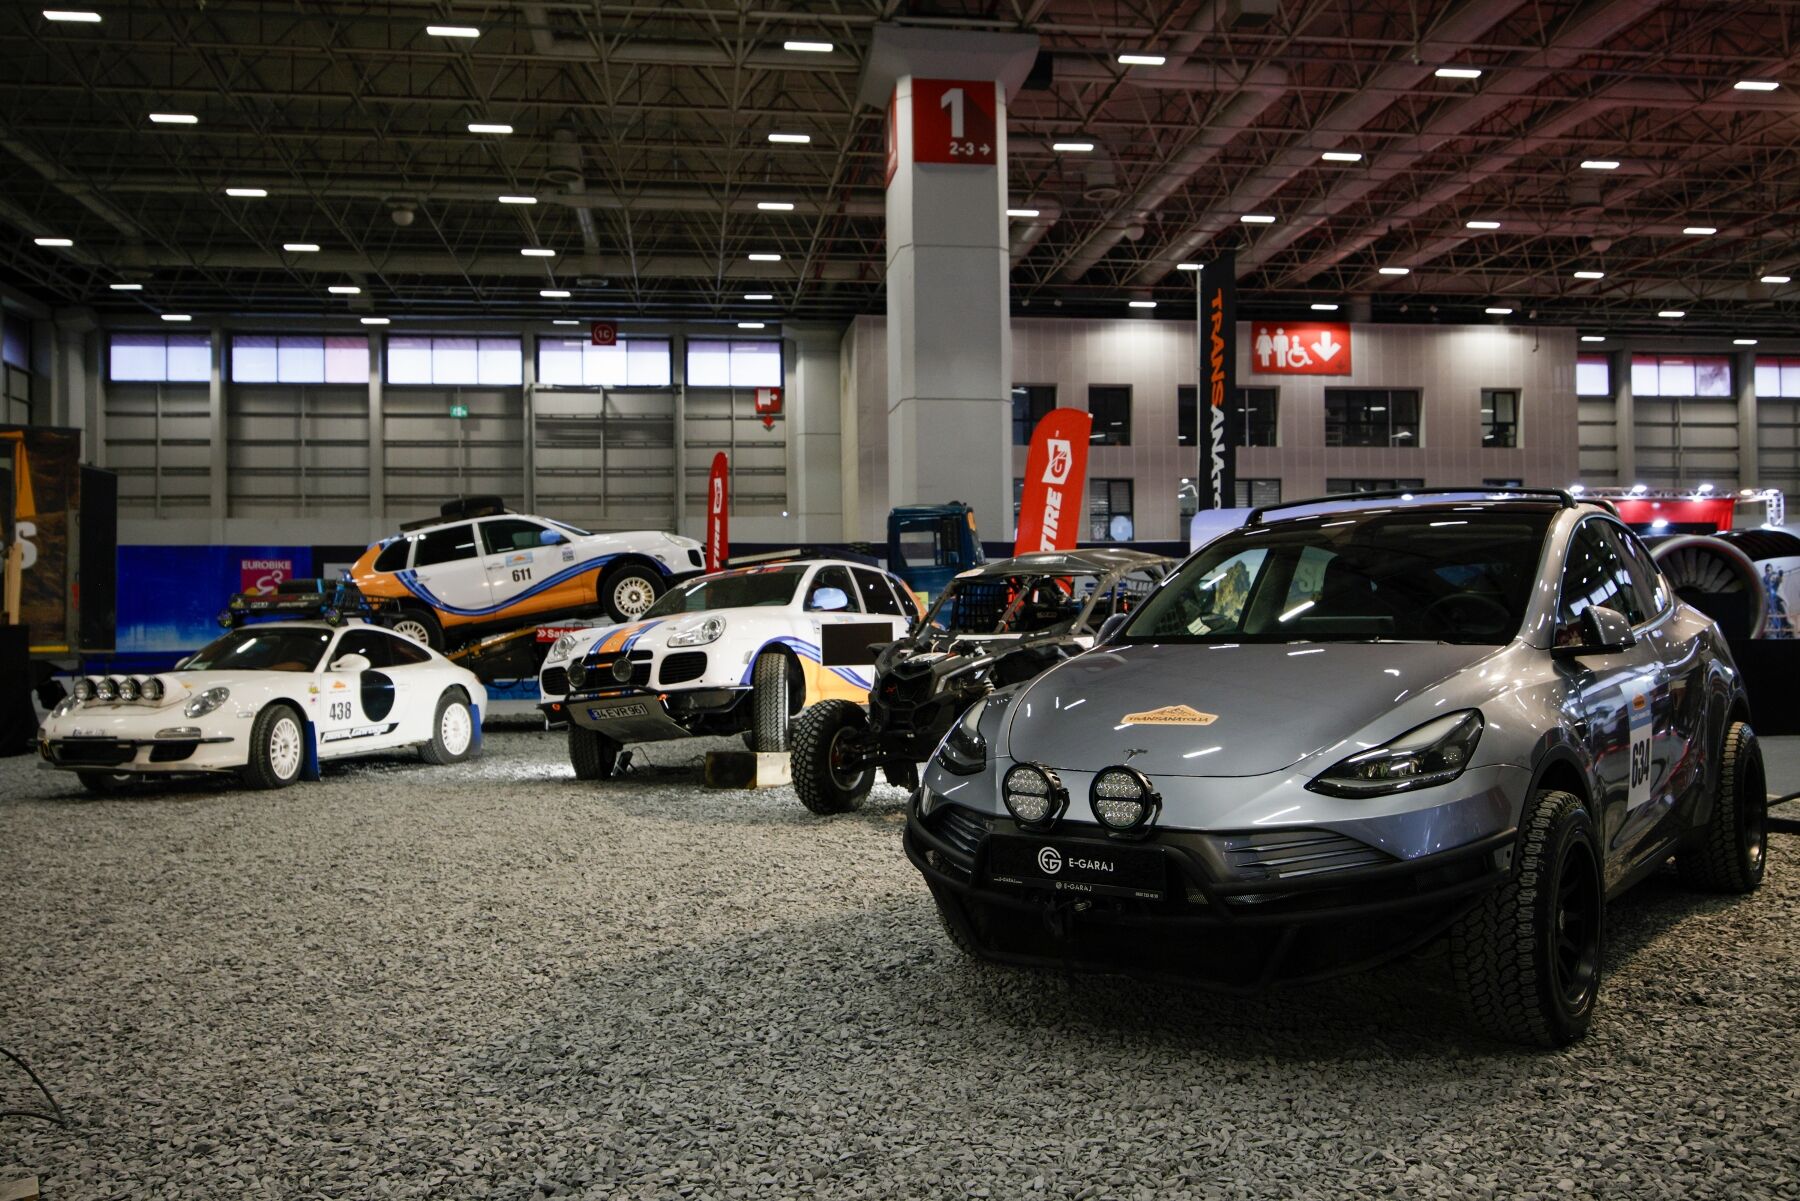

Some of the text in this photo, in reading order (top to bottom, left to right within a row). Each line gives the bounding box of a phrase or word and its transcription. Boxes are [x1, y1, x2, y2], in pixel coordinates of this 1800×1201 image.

[941, 88, 964, 138] 1
[949, 141, 975, 156] 2-3
[598, 330, 610, 338] 1C
[1040, 488, 1063, 552] TIRE
[241, 560, 292, 570] EUROBIKE
[512, 567, 532, 582] 611
[329, 701, 352, 720] 438
[1631, 738, 1650, 789] 634
[1068, 857, 1114, 872] E-GARAJ
[1063, 883, 1092, 892] E-GARAJ
